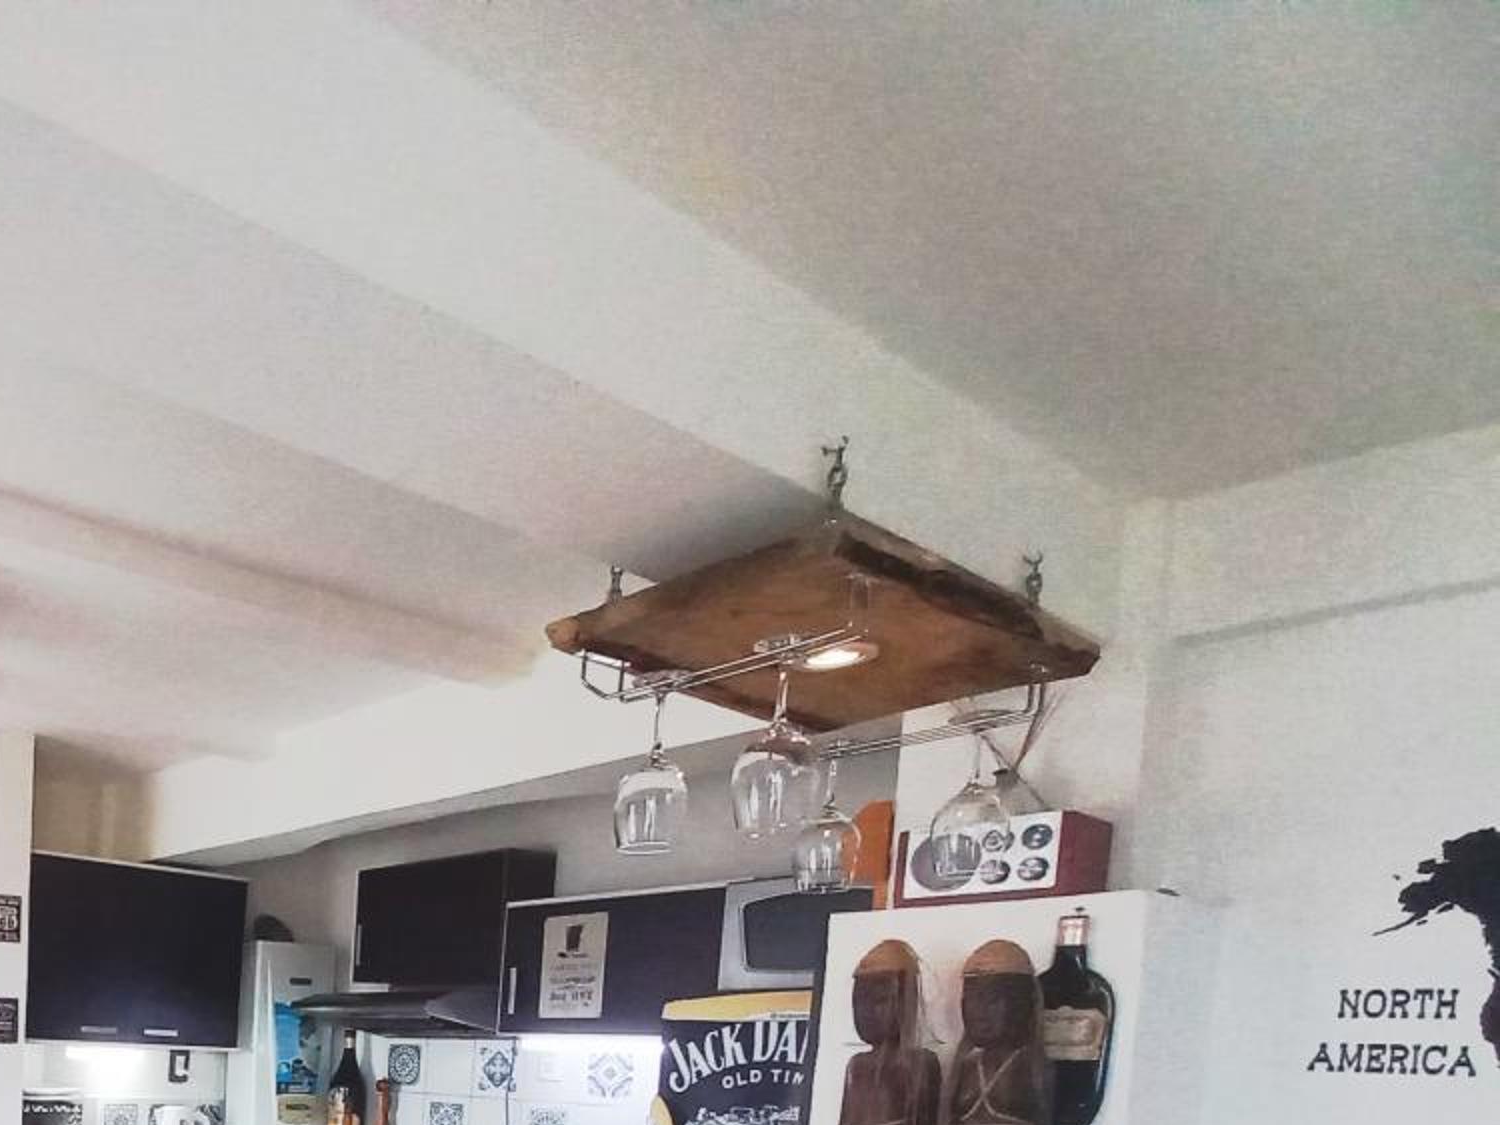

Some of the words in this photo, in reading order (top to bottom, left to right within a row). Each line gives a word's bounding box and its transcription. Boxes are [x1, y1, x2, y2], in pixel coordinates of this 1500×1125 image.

[1337, 988, 1460, 1020] NORTH
[669, 1023, 748, 1093] JACK
[1306, 1042, 1477, 1078] AMERICA
[721, 1069, 764, 1089] OLD
